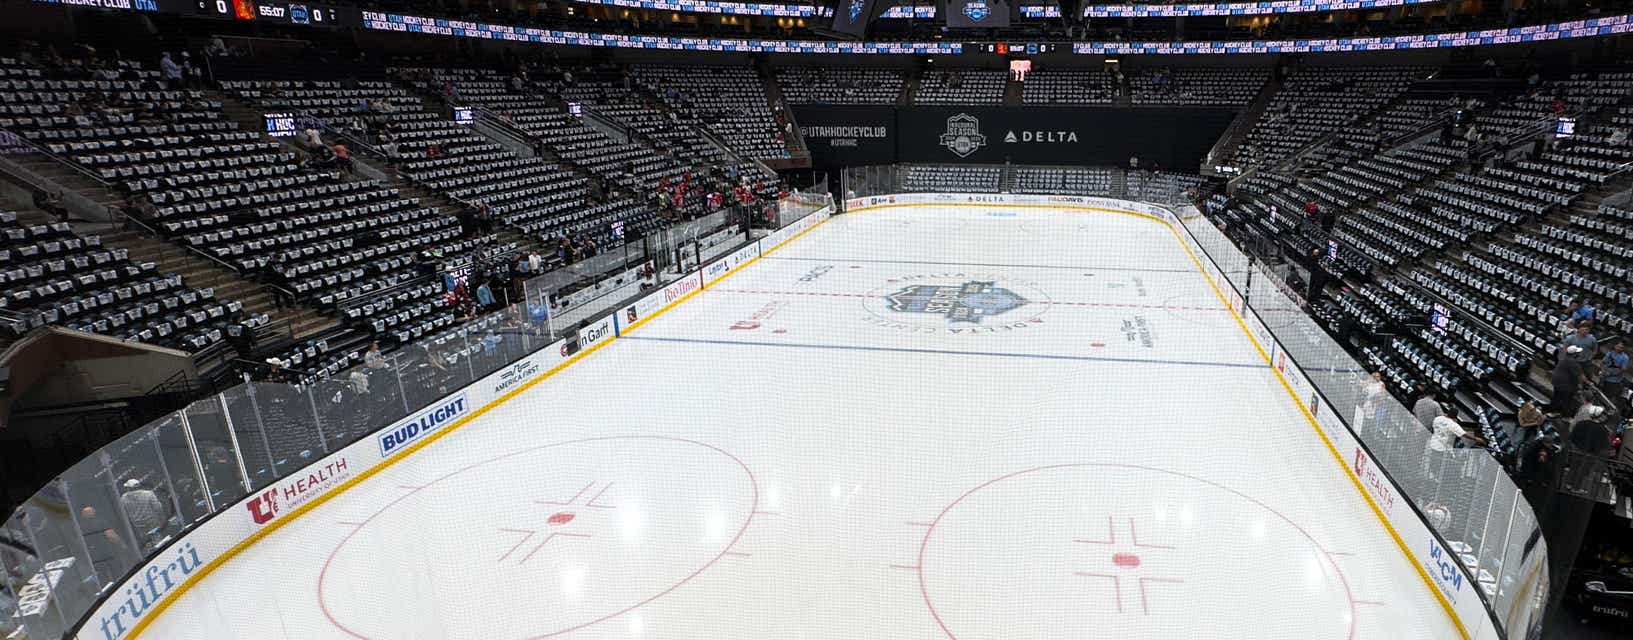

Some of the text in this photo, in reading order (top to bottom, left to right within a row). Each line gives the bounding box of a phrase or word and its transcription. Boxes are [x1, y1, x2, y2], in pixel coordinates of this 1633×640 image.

[216, 0, 227, 13] 0
[259, 6, 285, 17] 55:07
[313, 10, 322, 21] 0
[801, 126, 887, 138] @UTAHHOCKEYCLUB
[949, 128, 977, 136] SEASON
[1023, 131, 1078, 143] DELTA
[495, 364, 539, 392] AMERICA FIRST
[382, 398, 465, 451] BUD LIGHT
[284, 458, 347, 501] HEALTH
[1367, 470, 1394, 507] HEALTH
[100, 543, 203, 640] trüfrü
